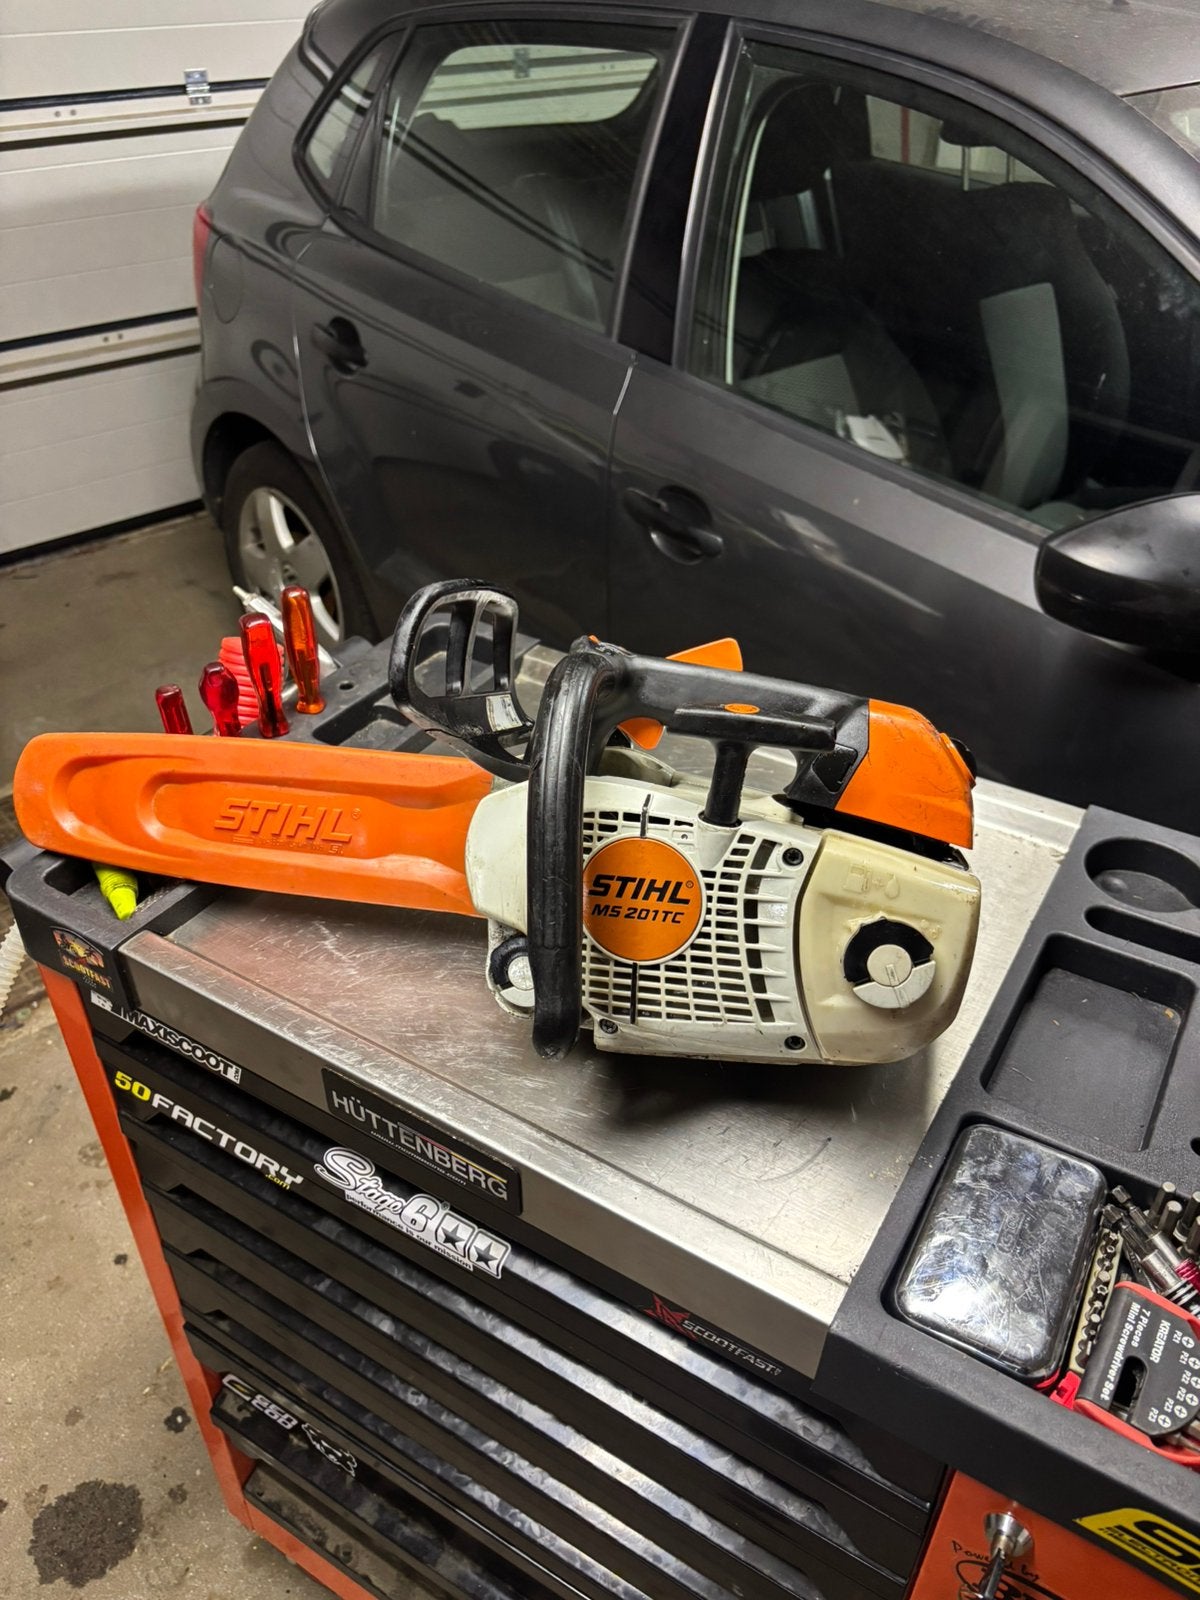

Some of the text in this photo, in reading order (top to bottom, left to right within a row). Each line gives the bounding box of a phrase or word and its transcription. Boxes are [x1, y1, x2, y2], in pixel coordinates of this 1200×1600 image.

[214, 798, 352, 844] STIHL
[588, 874, 691, 905] STIHL
[591, 904, 622, 918] MS
[121, 1007, 234, 1078] MAXISCOOT
[332, 1090, 508, 1201] HÜTTENBERG
[346, 1194, 472, 1269] performance is our mission
[1131, 1308, 1151, 1347] 7 Pieces
[1150, 1320, 1171, 1363] KREATOR
[1172, 1329, 1182, 1344] PZ1
[682, 1320, 776, 1373] SCOOTFAST
[1100, 1302, 1141, 1401] Mini Screwdriver Set
[1179, 1350, 1189, 1365] PZ1
[1176, 1386, 1187, 1402] PZ2
[1181, 1369, 1192, 1385] PZ2
[1148, 1407, 1159, 1423] PZ3
[1164, 1397, 1175, 1413] PZ3
